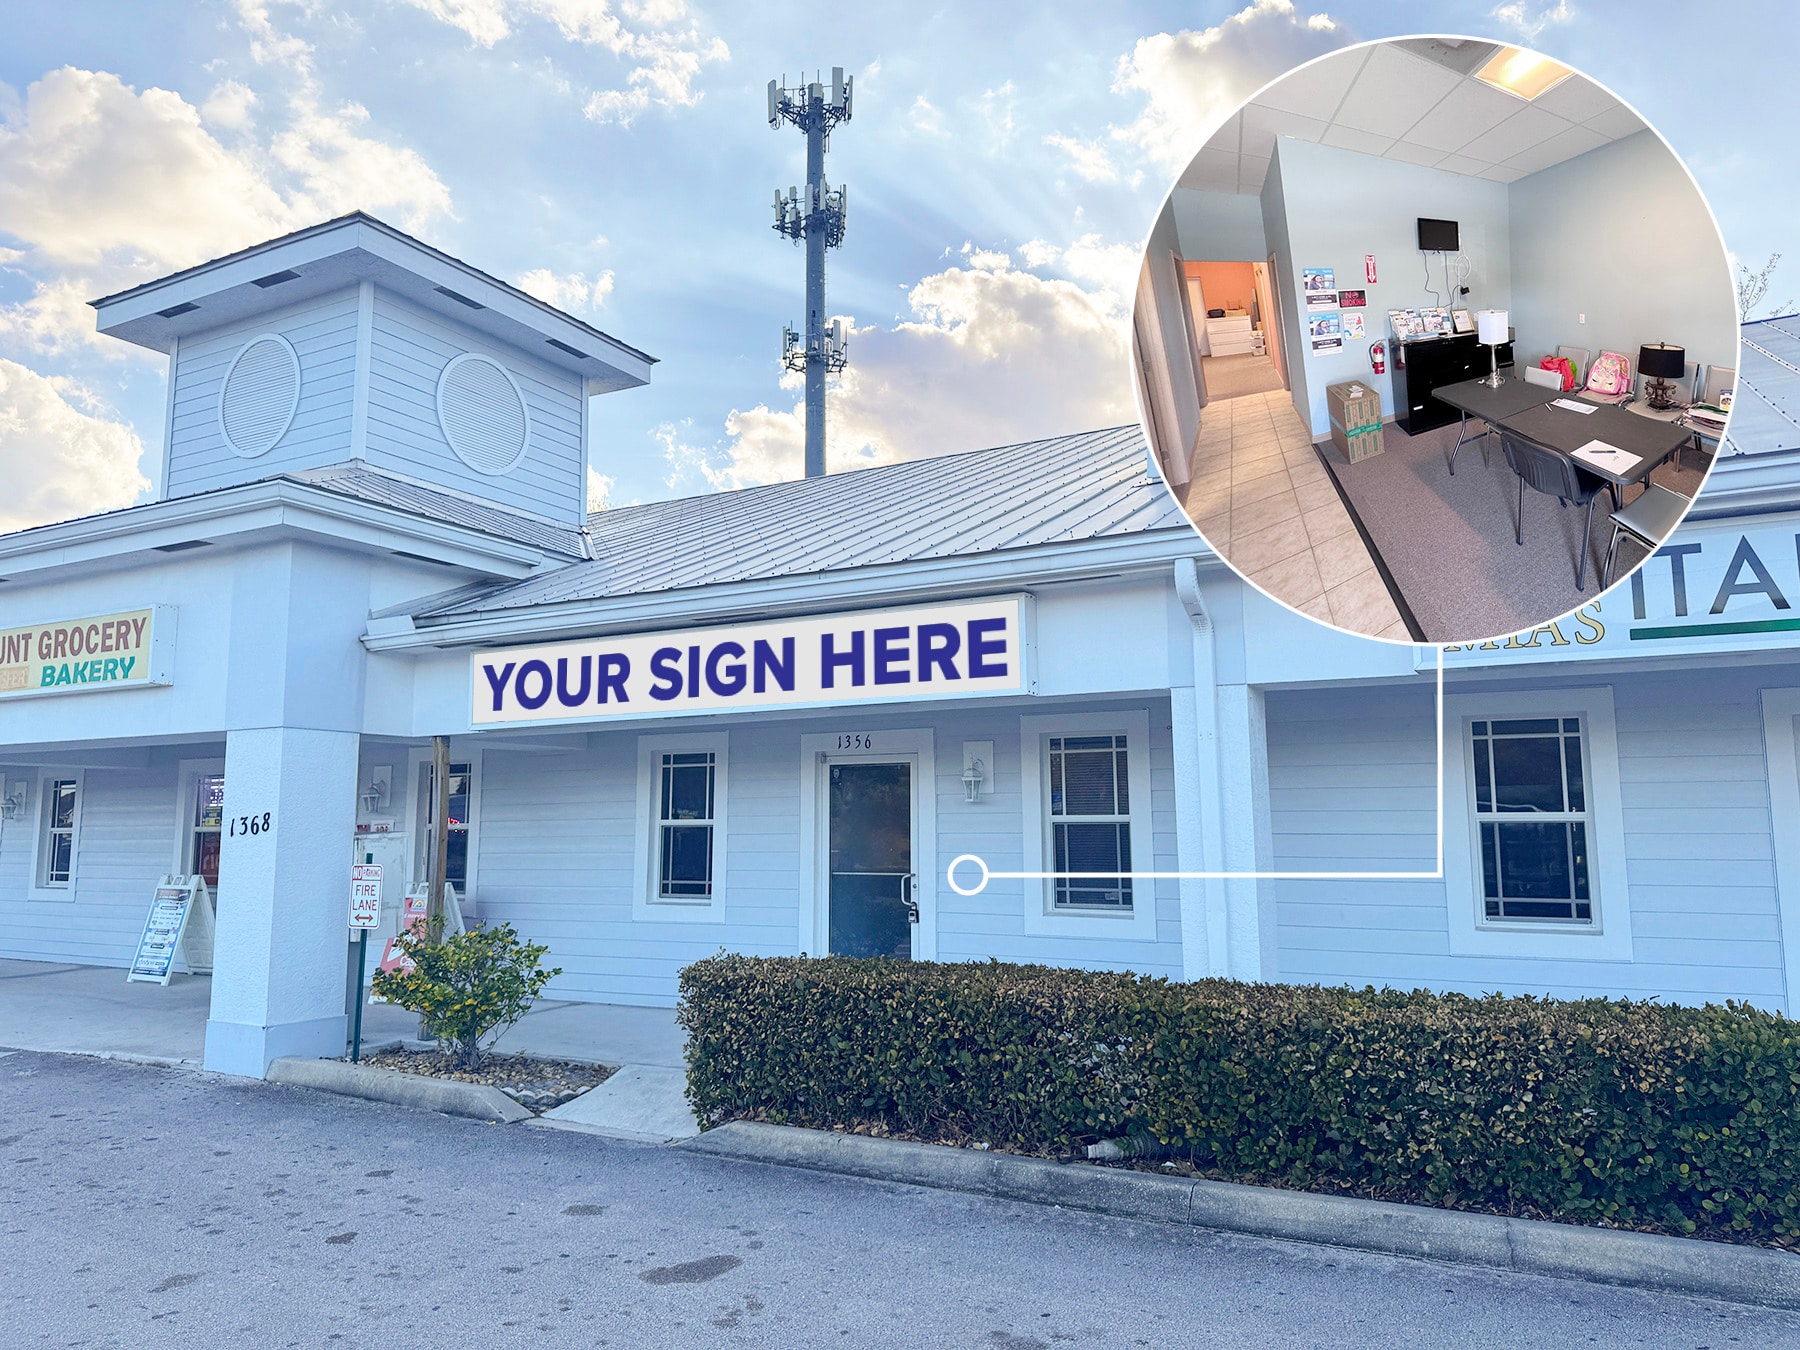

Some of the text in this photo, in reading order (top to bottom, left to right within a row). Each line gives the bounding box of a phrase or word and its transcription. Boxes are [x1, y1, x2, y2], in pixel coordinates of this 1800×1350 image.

[1631, 534, 1800, 619] ITA
[38, 617, 147, 660] GROCERY
[1444, 601, 1606, 652] AS
[40, 656, 135, 687] BAKERY
[483, 617, 1008, 711] YOUR SIGN HERE
[838, 734, 871, 749] 1356
[230, 812, 271, 837] 1368
[353, 866, 362, 880] NO
[356, 884, 376, 896] FIRE
[352, 899, 377, 911] LANE
